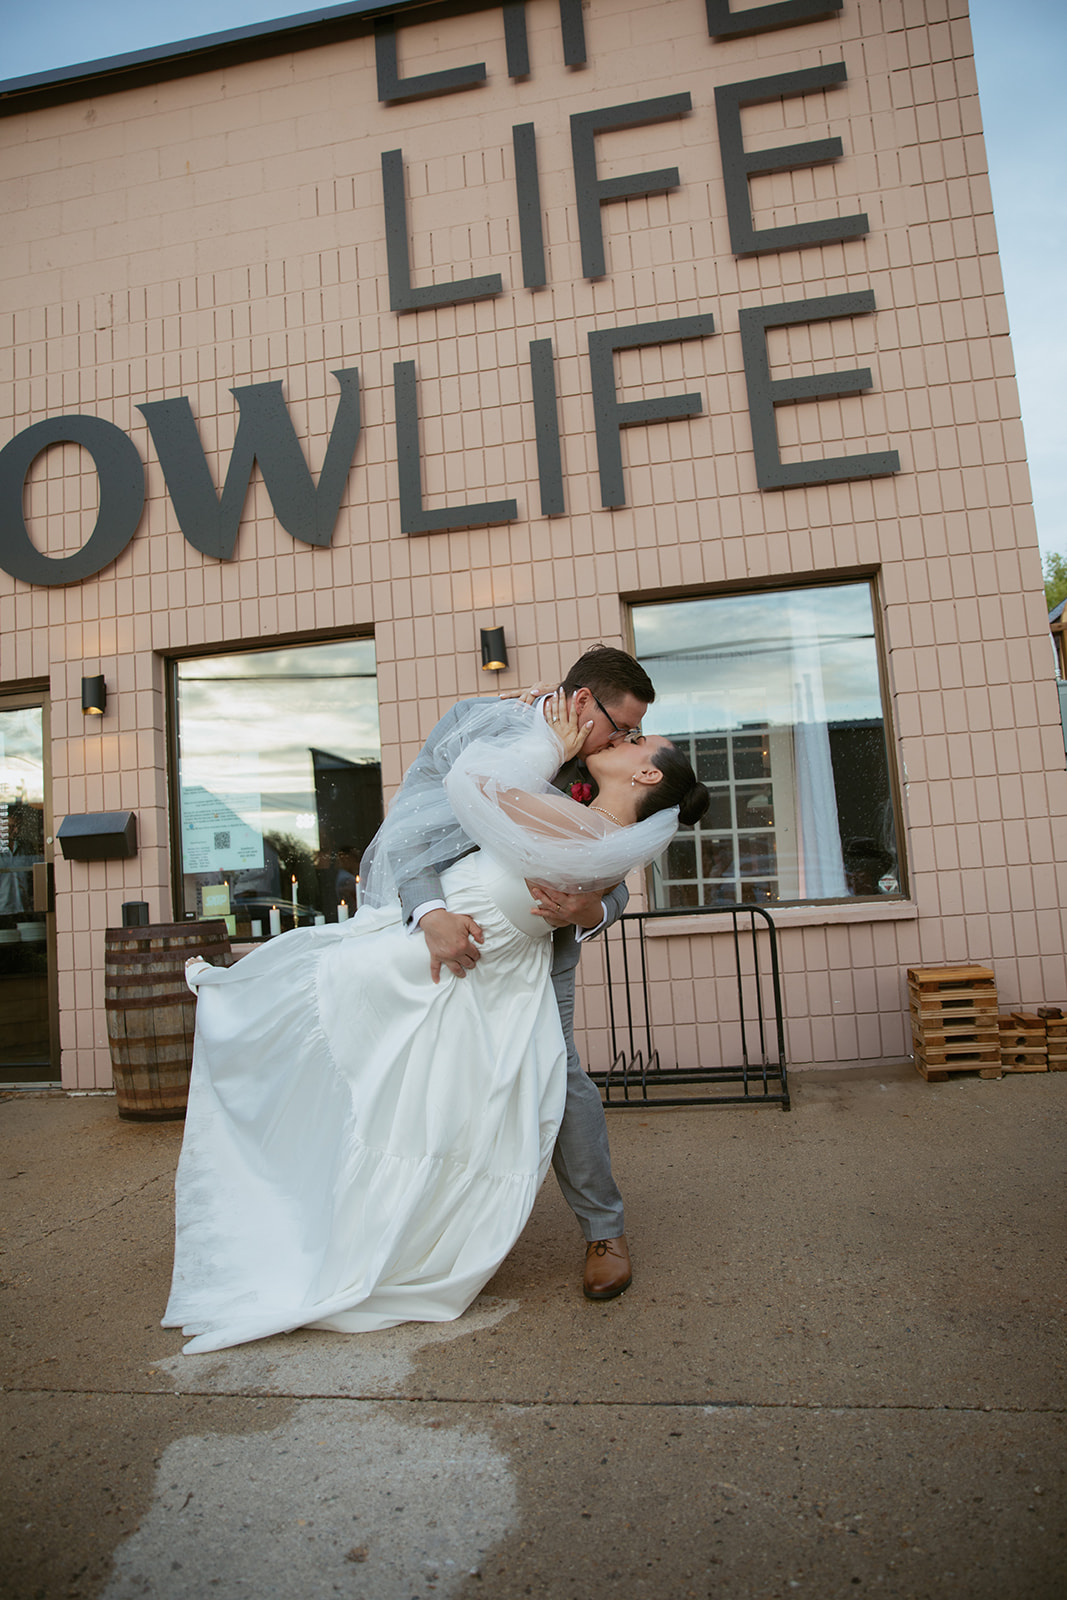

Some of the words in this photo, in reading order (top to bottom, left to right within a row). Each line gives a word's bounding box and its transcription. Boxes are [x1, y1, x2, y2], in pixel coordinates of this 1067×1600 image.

[381, 62, 870, 312] LIFE
[0, 367, 361, 586] OW
[393, 290, 902, 534] LIFE
